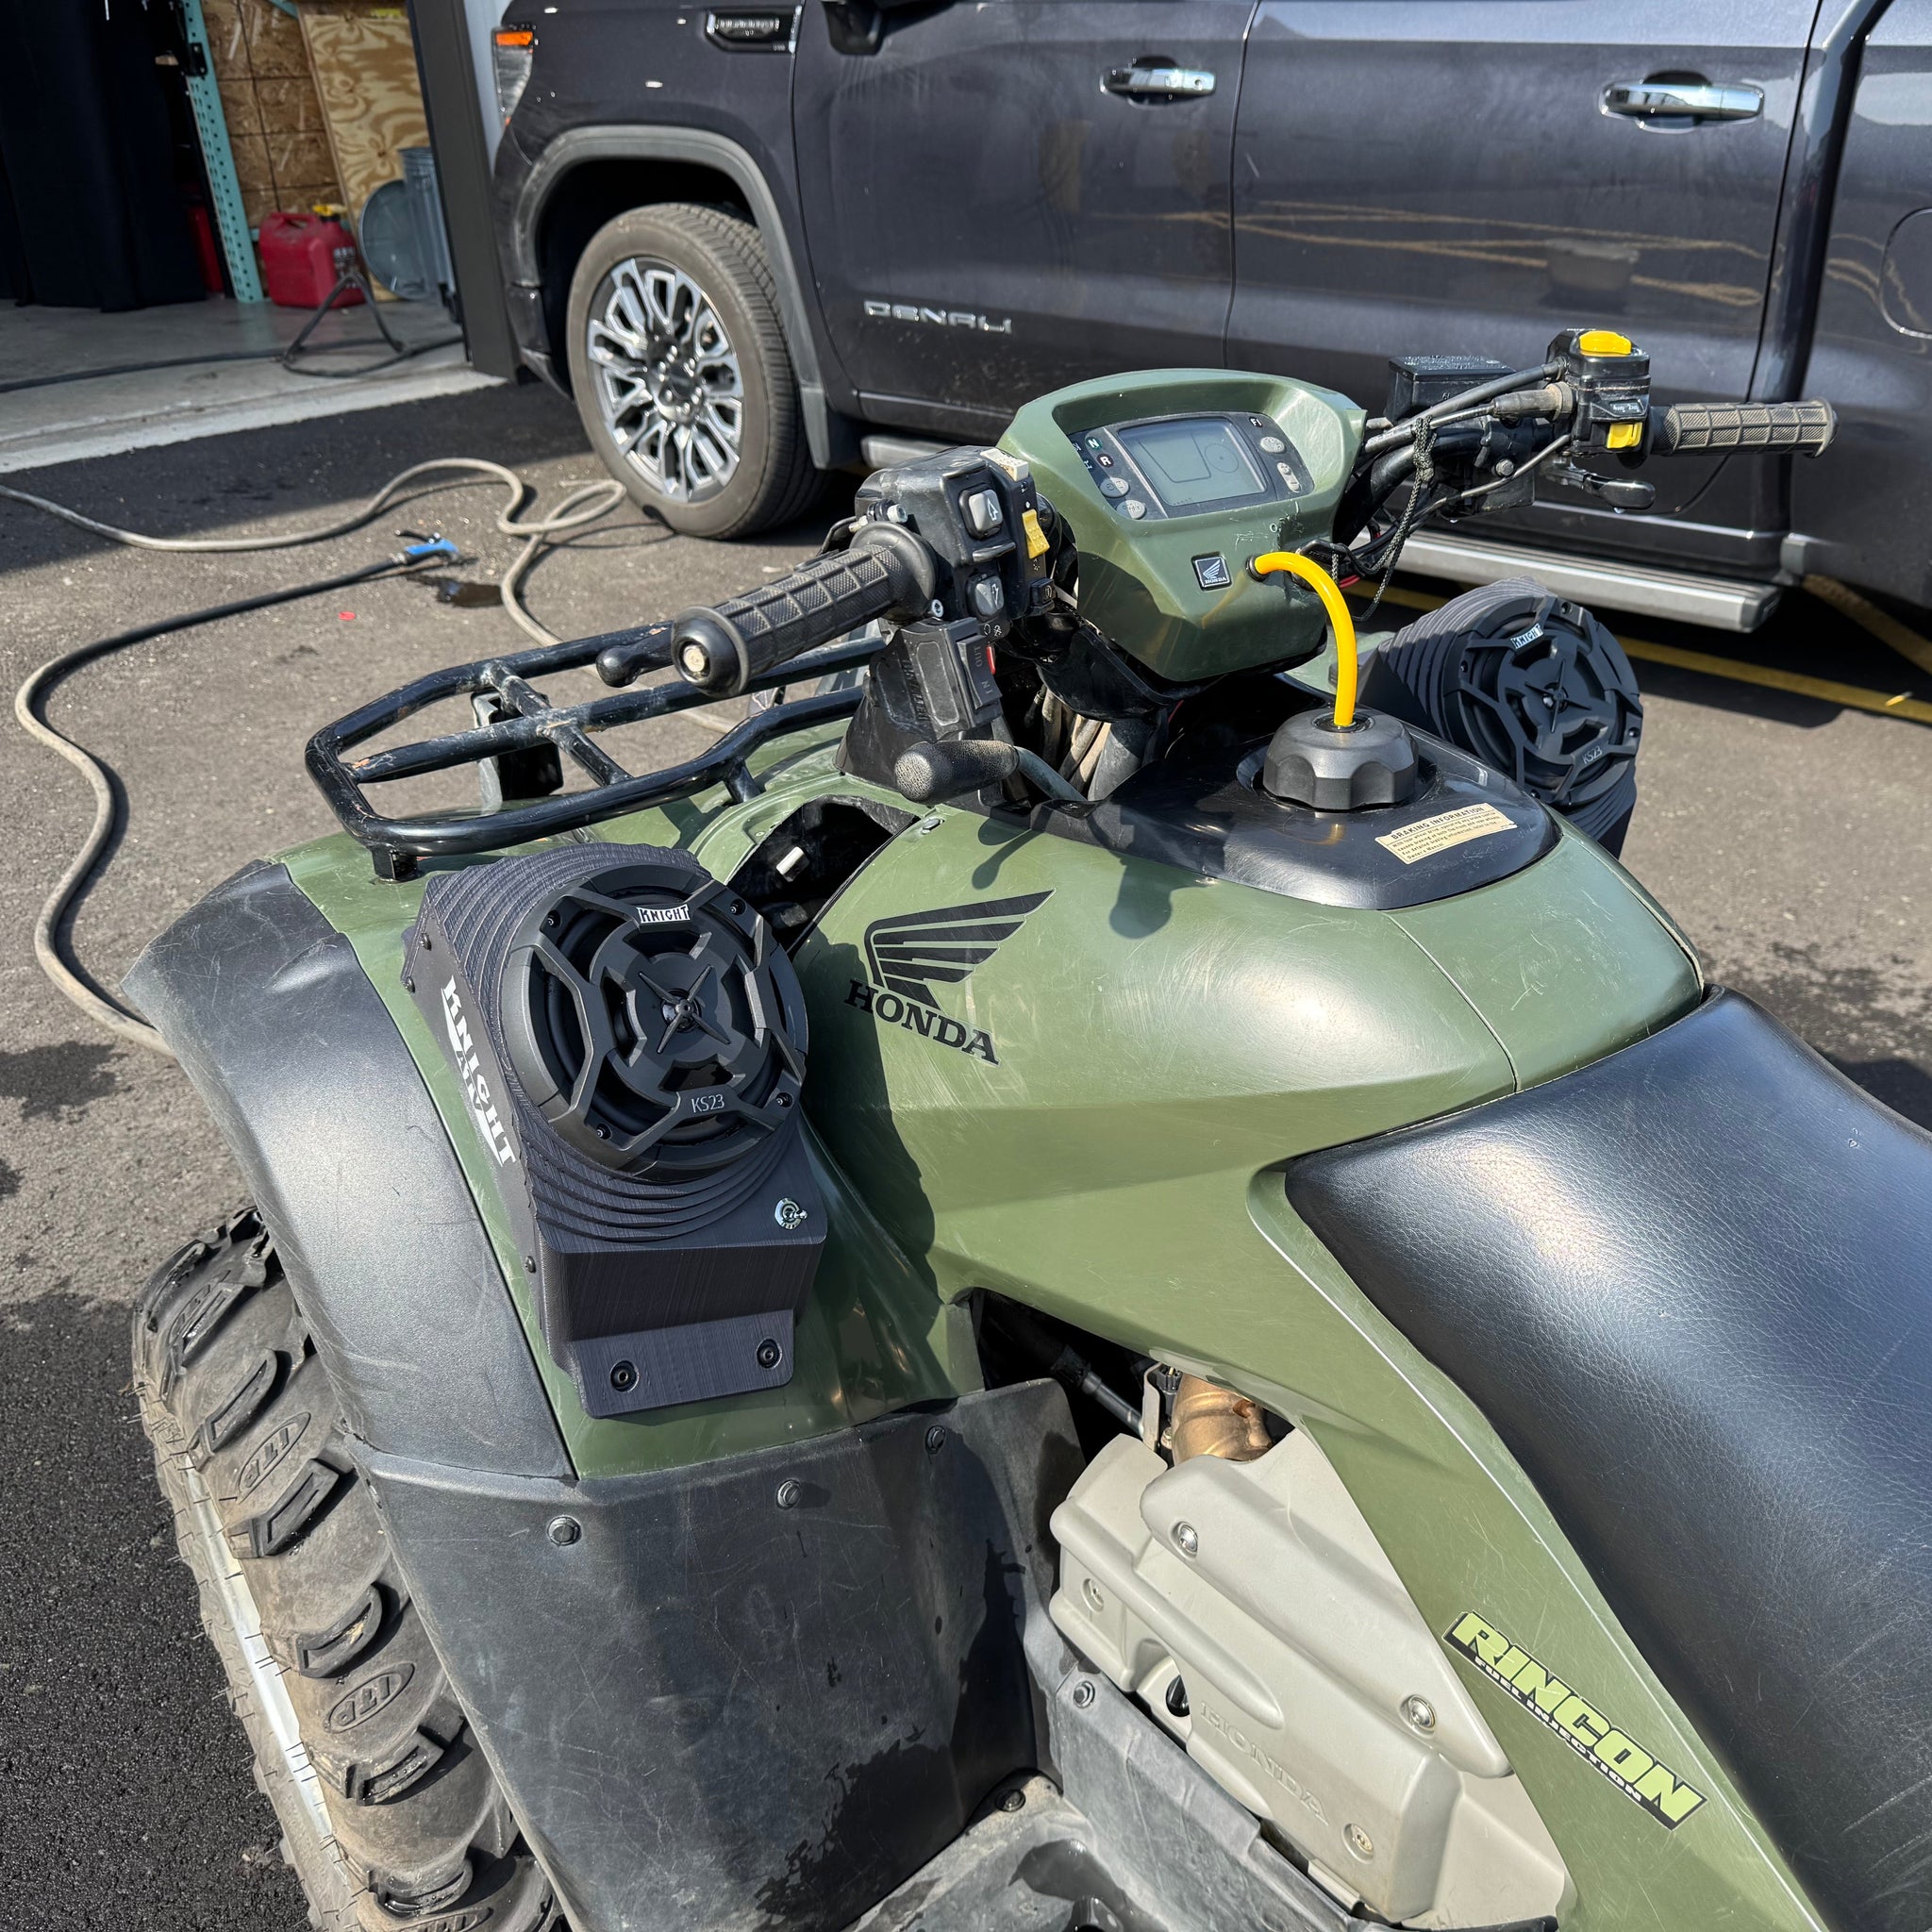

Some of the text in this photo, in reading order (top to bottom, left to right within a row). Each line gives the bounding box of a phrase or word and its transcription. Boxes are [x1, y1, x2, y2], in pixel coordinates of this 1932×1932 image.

[863, 301, 1011, 334] DENALI
[1088, 438, 1100, 449] N
[1099, 456, 1111, 466] R
[1511, 624, 1543, 649] KNIGHT
[1582, 746, 1603, 765] KS23
[1391, 808, 1485, 839] BRAKING INFORMATION
[640, 905, 691, 923] KNIGHT
[844, 979, 999, 1066] HONDA
[443, 974, 516, 1165] KNIGHT
[691, 1093, 725, 1113] KS23
[244, 1427, 290, 1489] ITP
[337, 1674, 391, 1726] ITP
[1451, 1612, 1704, 1823] RINCON
[1474, 1656, 1642, 1803] FUEL INJECTION
[1201, 1702, 1329, 1826] HONDA
